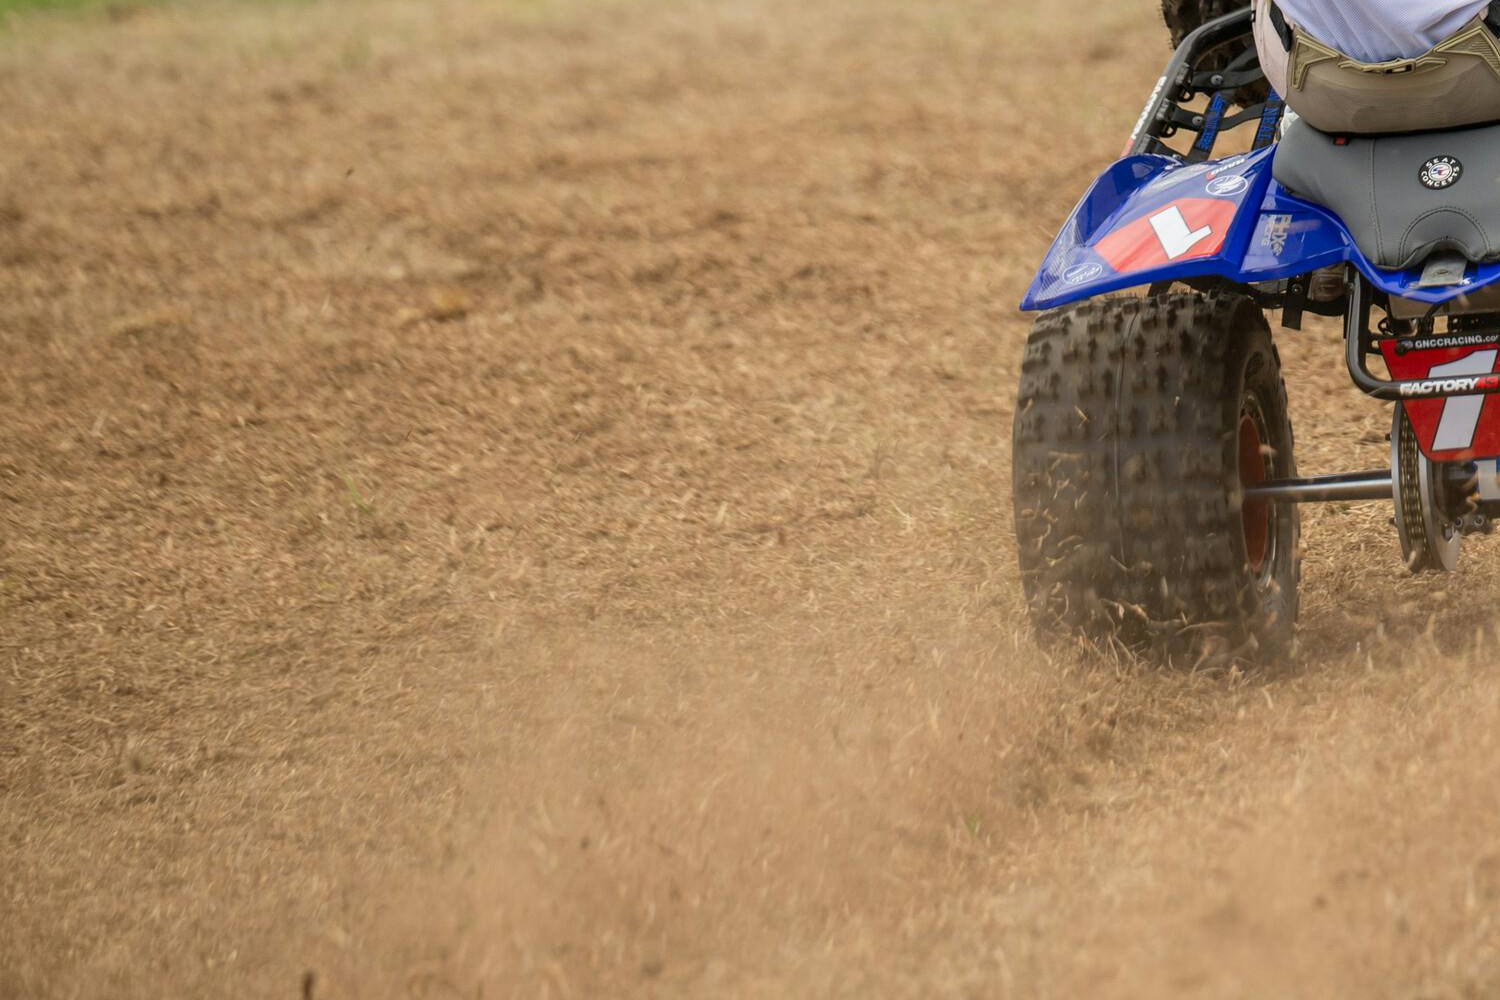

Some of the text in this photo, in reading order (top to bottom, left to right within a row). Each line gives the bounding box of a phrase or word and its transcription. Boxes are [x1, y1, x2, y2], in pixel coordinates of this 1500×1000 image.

[1426, 157, 1456, 168] SEAT
[1420, 166, 1460, 187] CONCEPTS
[1427, 349, 1499, 451] 1
